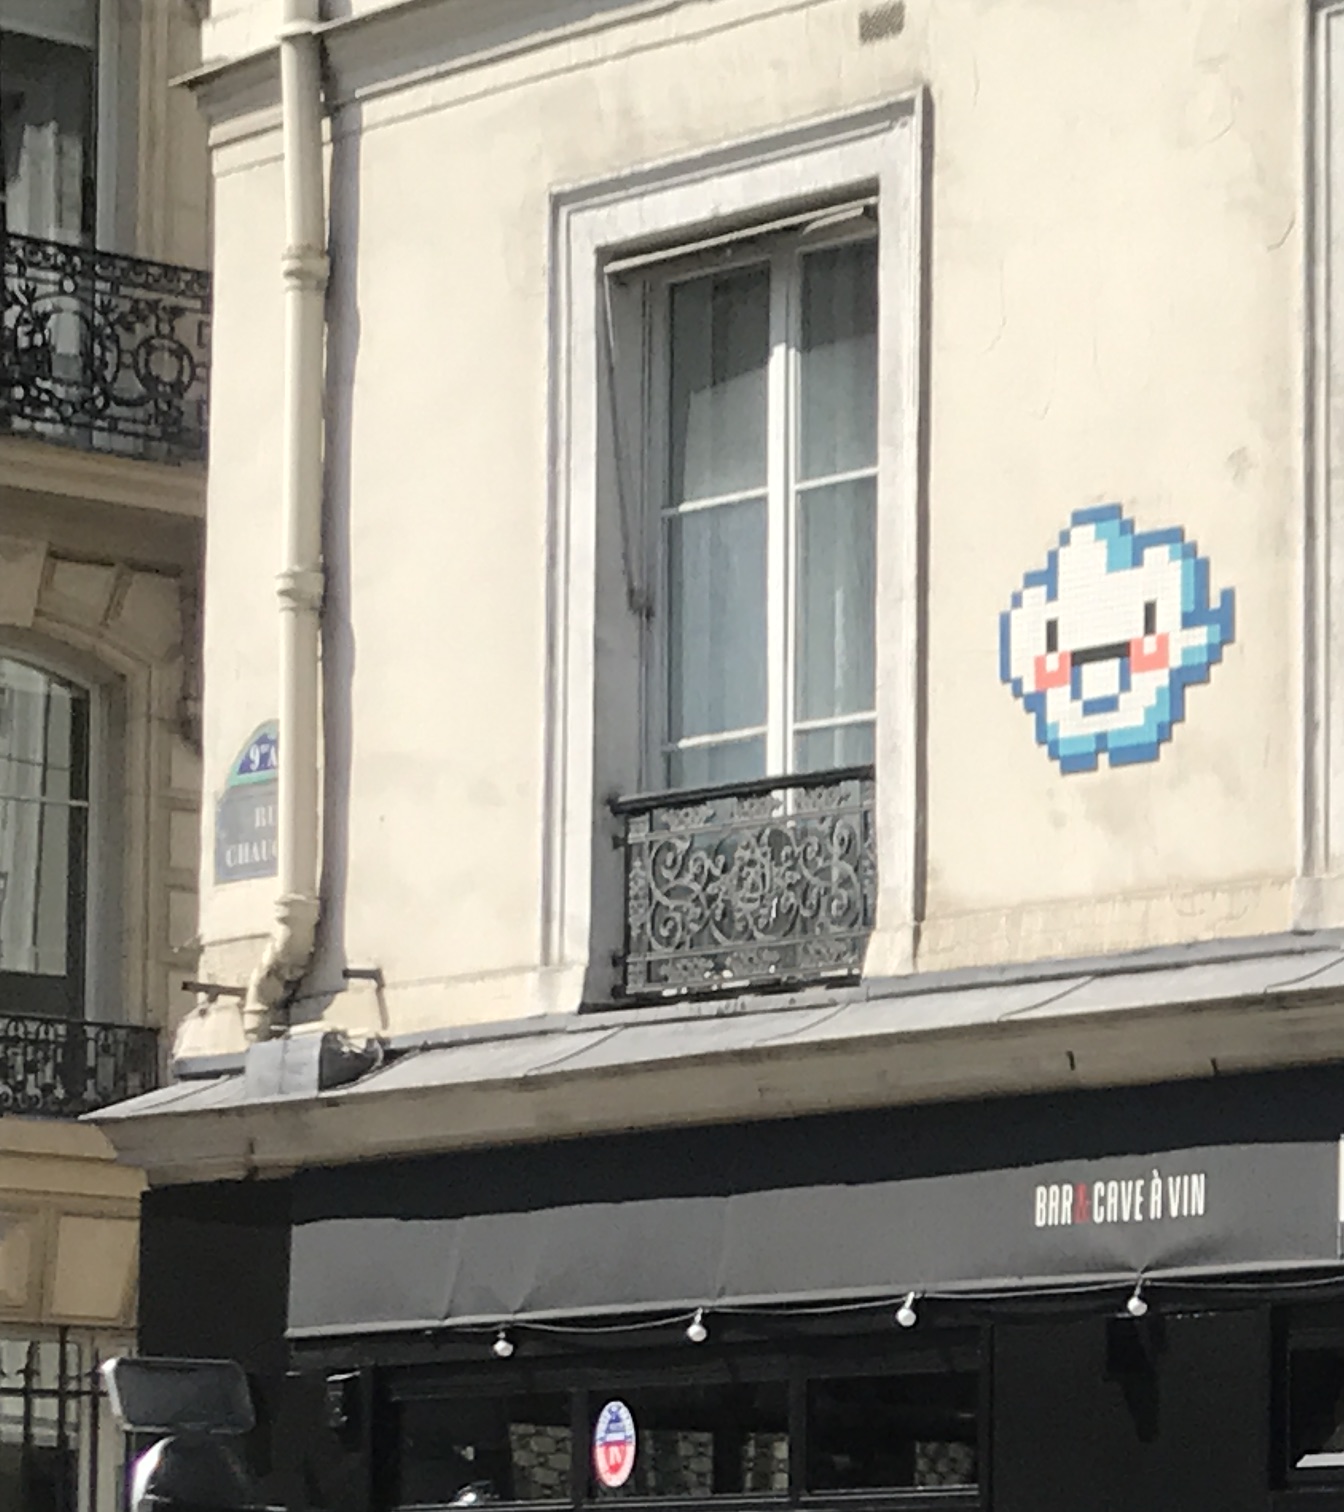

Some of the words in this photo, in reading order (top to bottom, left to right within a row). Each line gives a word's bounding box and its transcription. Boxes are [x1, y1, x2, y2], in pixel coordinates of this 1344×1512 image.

[254, 804, 276, 829] RU
[1149, 1168, 1163, 1220] À
[1167, 1173, 1206, 1219] VIN
